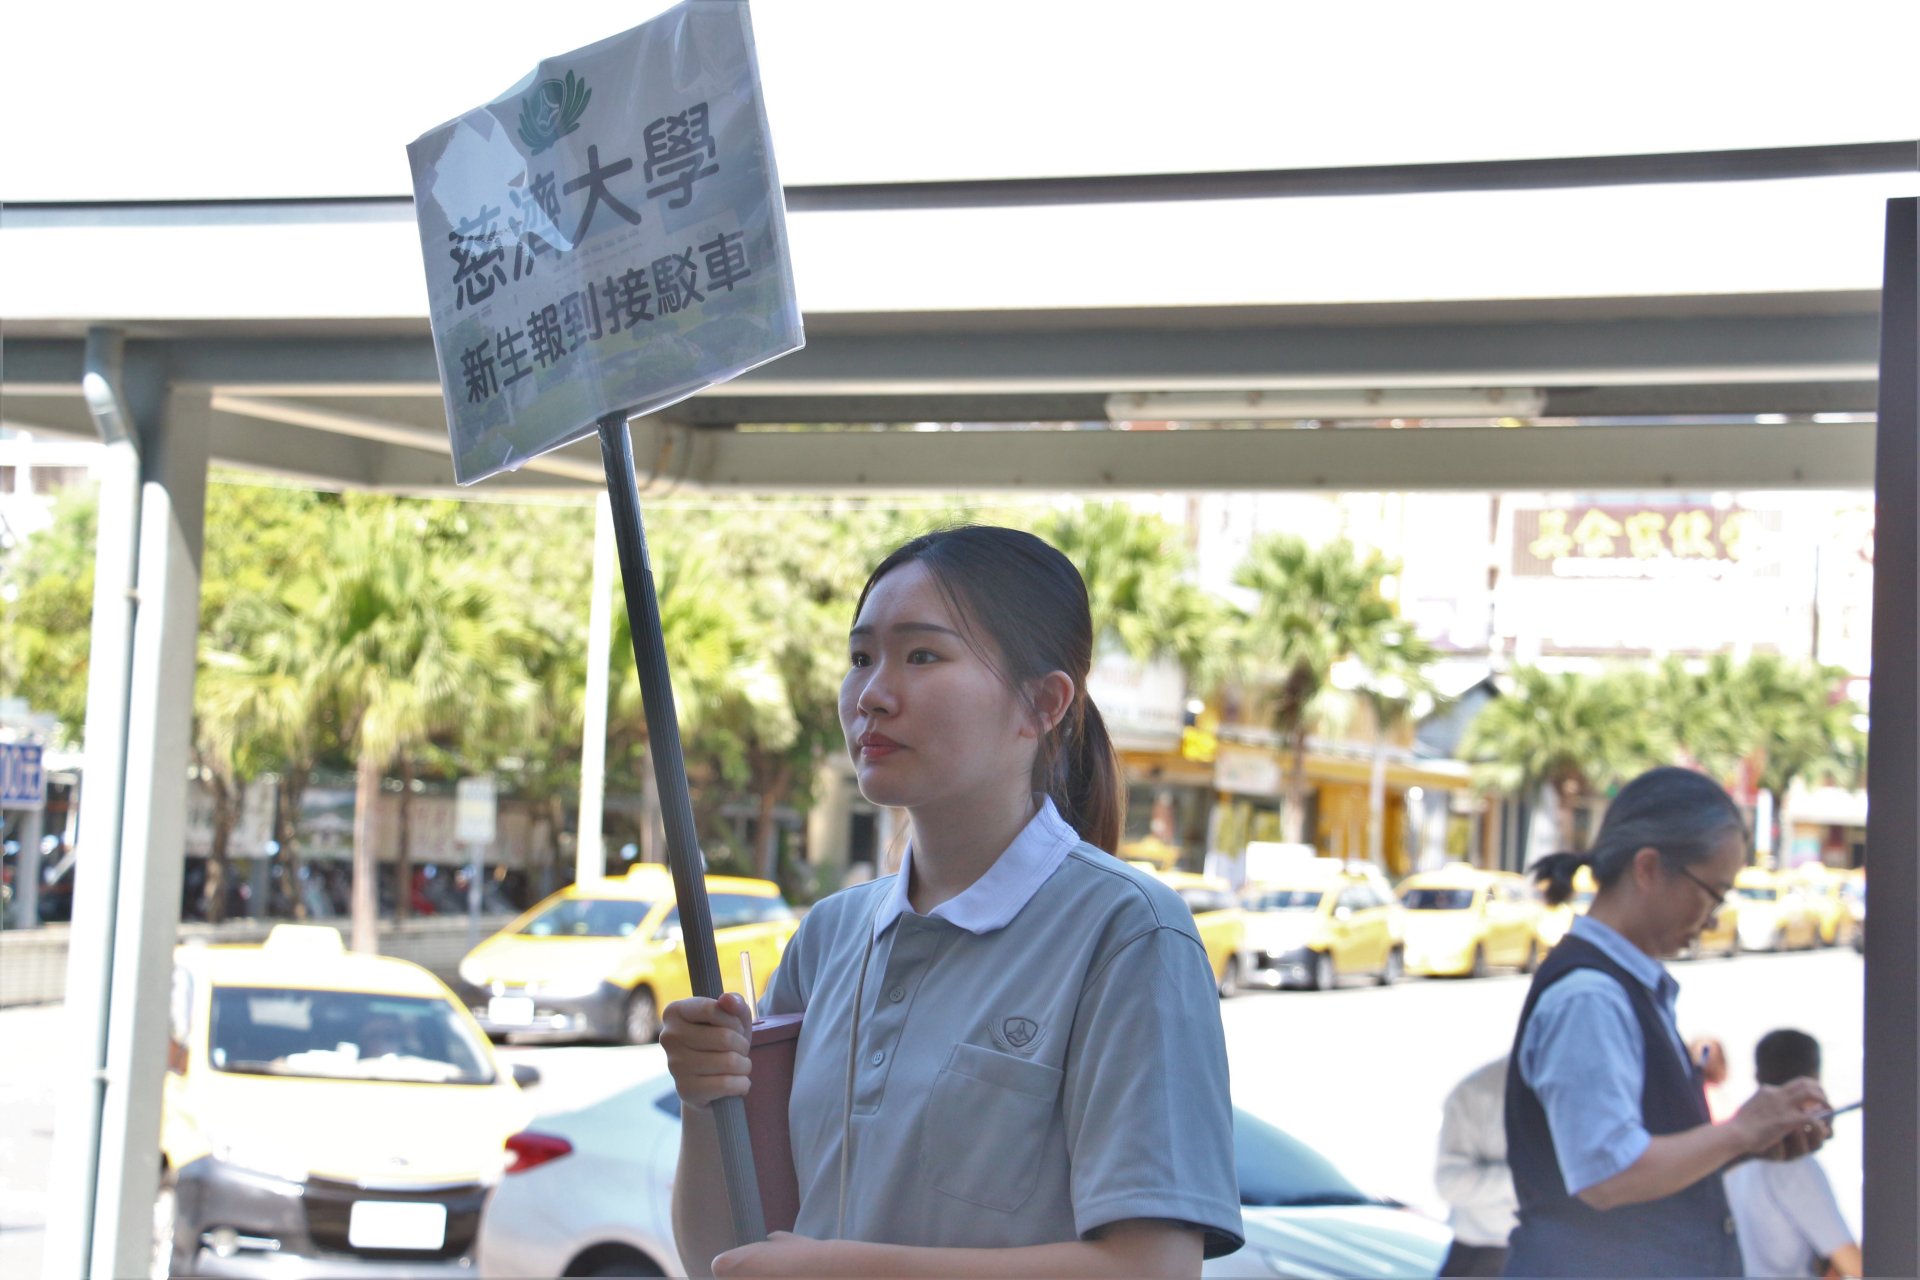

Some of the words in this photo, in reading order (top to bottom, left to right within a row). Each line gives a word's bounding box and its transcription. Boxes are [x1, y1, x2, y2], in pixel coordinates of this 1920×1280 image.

[448, 102, 719, 311] 慈濟大學
[460, 232, 751, 403] 新生報到接駁車
